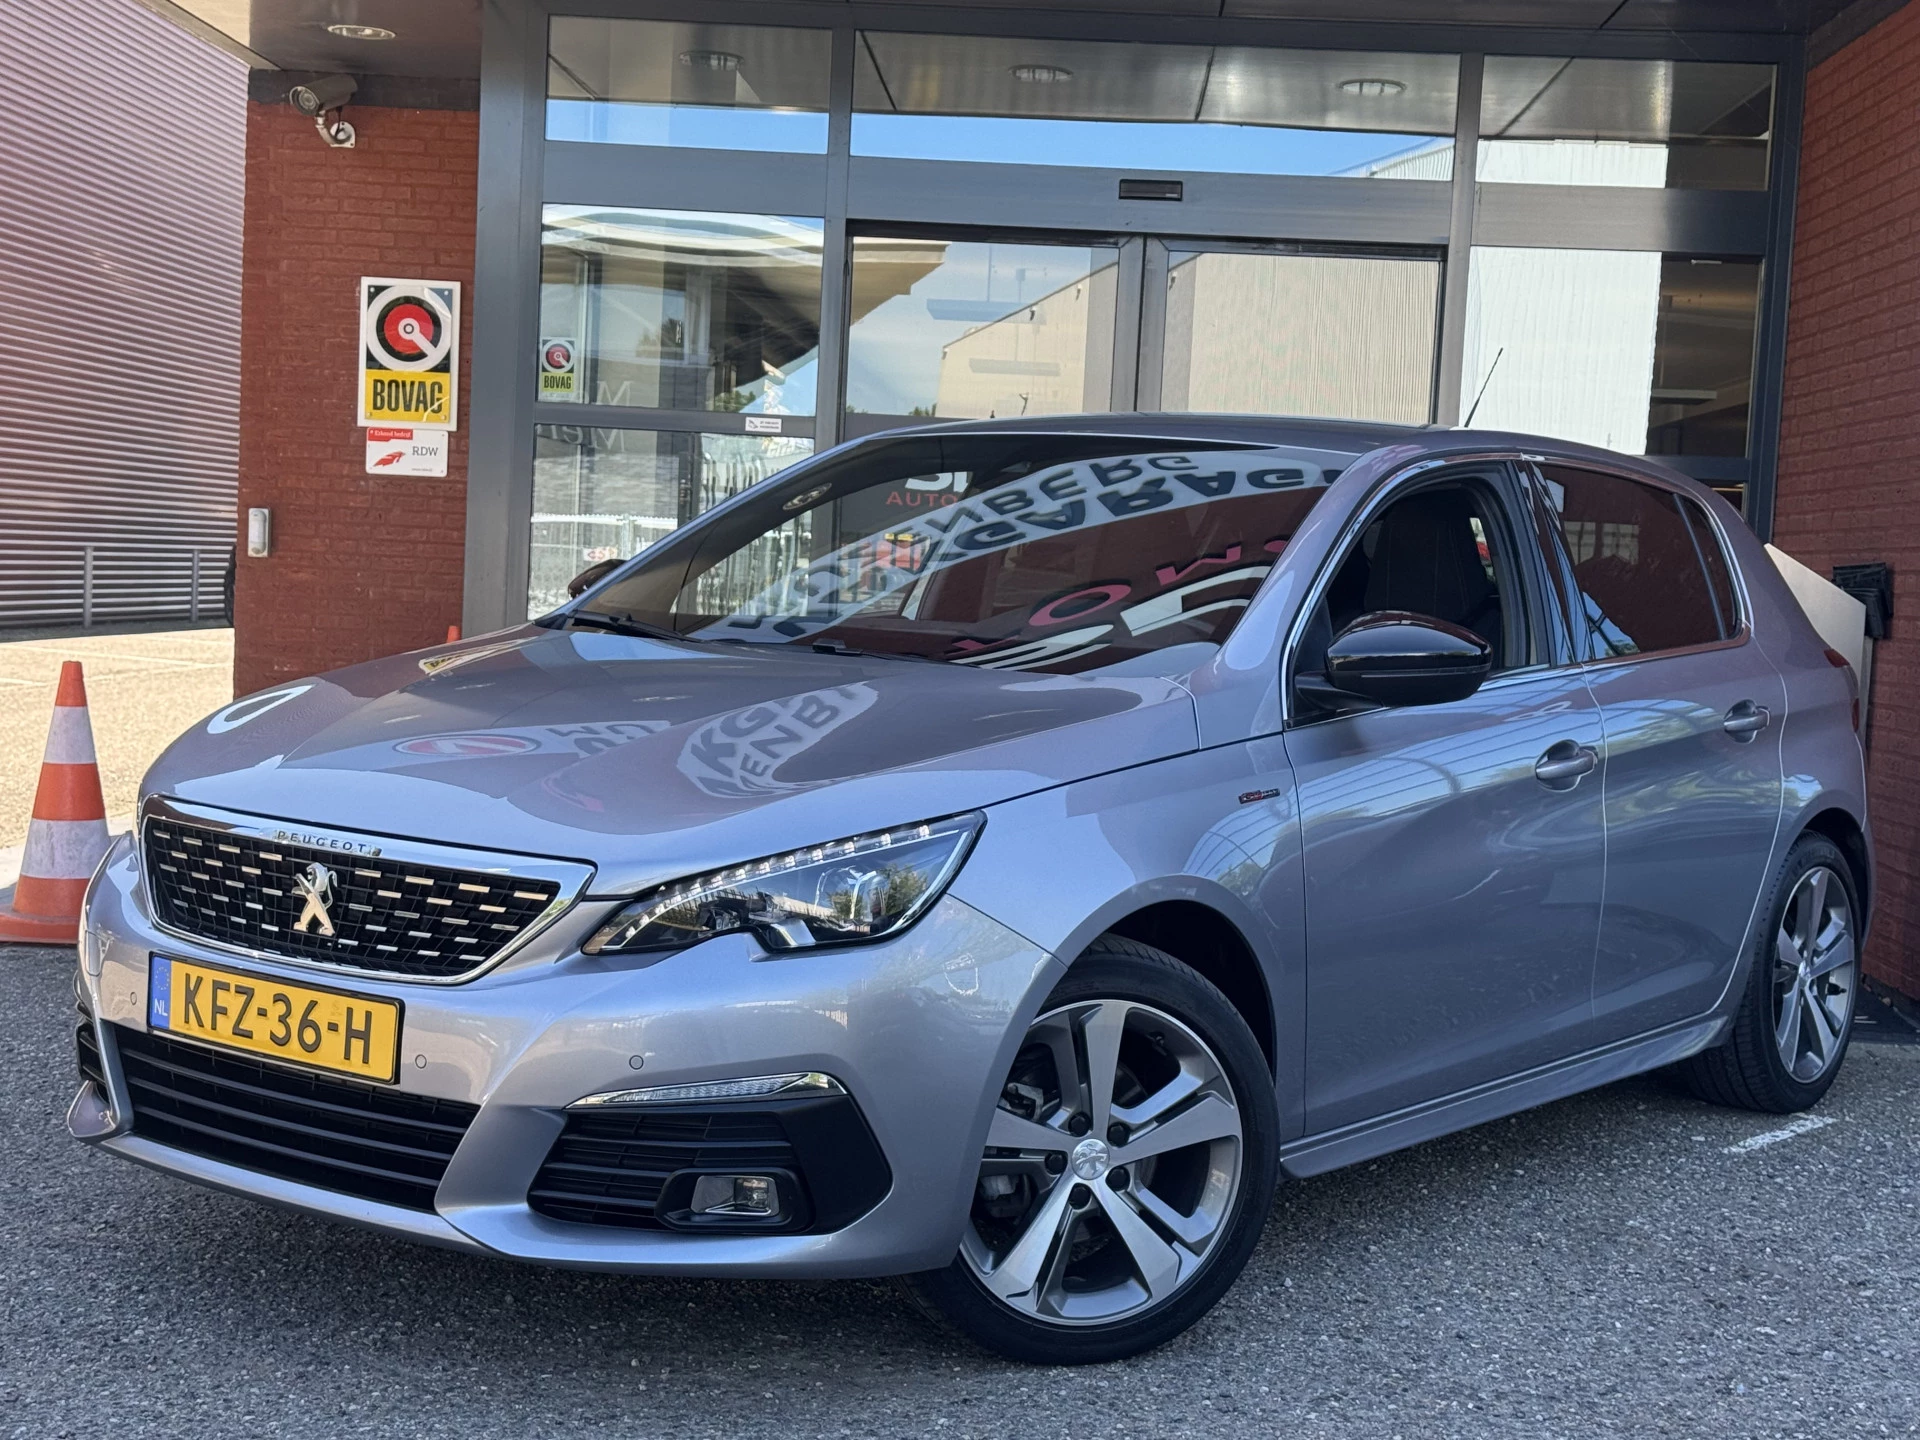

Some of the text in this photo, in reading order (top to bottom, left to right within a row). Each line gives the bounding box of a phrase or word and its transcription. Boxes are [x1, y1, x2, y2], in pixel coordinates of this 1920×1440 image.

[544, 375, 572, 389] BOVAG
[372, 379, 443, 414] BOVAG
[412, 446, 438, 457] RDW
[277, 831, 366, 852] PEUGEOT
[154, 998, 168, 1017] NL
[184, 973, 372, 1064] KFZ-36-H
